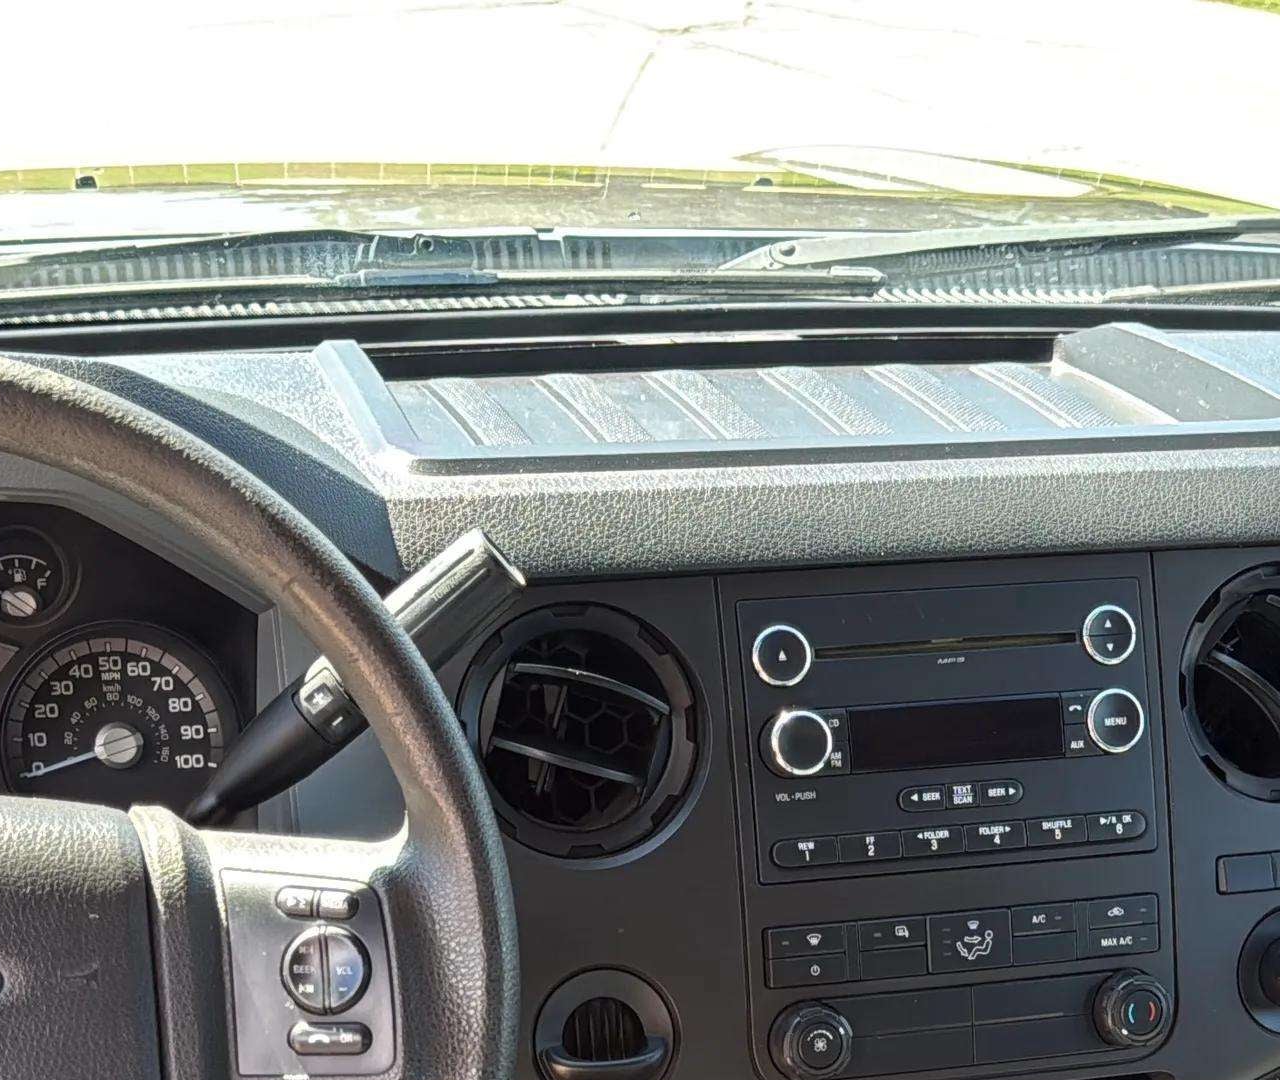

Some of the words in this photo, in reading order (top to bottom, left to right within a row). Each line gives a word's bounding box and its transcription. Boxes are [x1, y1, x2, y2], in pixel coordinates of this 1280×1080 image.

[37, 578, 47, 590] F
[98, 656, 121, 671] 50
[69, 664, 93, 679] 40
[127, 662, 151, 677] 60
[101, 672, 120, 681] MPH
[50, 680, 73, 695] 30
[102, 683, 122, 693] km/h
[151, 676, 173, 692] 70
[106, 692, 120, 701] 80
[127, 694, 143, 707] 100
[84, 697, 98, 709] 60
[168, 697, 192, 712] 80
[34, 703, 59, 718] 20
[146, 706, 160, 721] 120
[829, 719, 840, 727] CD
[1104, 716, 1127, 726] MENU
[180, 725, 204, 740] 90
[28, 732, 47, 747] 10
[1071, 740, 1085, 749] AUX
[831, 752, 842, 760] AM
[175, 754, 204, 769] 100
[831, 760, 842, 768] FM
[953, 785, 972, 794] TEXT
[988, 788, 1006, 797] SEEK
[922, 792, 941, 801] SEEK
[953, 795, 973, 804] SCAN
[1042, 820, 1072, 830] SHUFFLE
[924, 830, 950, 839] FOLDER
[979, 826, 1004, 836] FOLDER
[1055, 829, 1062, 840] 5
[866, 836, 875, 845] FF
[993, 834, 1001, 845] 4
[798, 842, 815, 850] REW
[931, 840, 938, 850] 3
[868, 845, 875, 856] 2
[805, 851, 809, 861] 1
[1032, 914, 1046, 923] A/C
[1101, 938, 1117, 947] MAX
[1119, 936, 1133, 945] A/C
